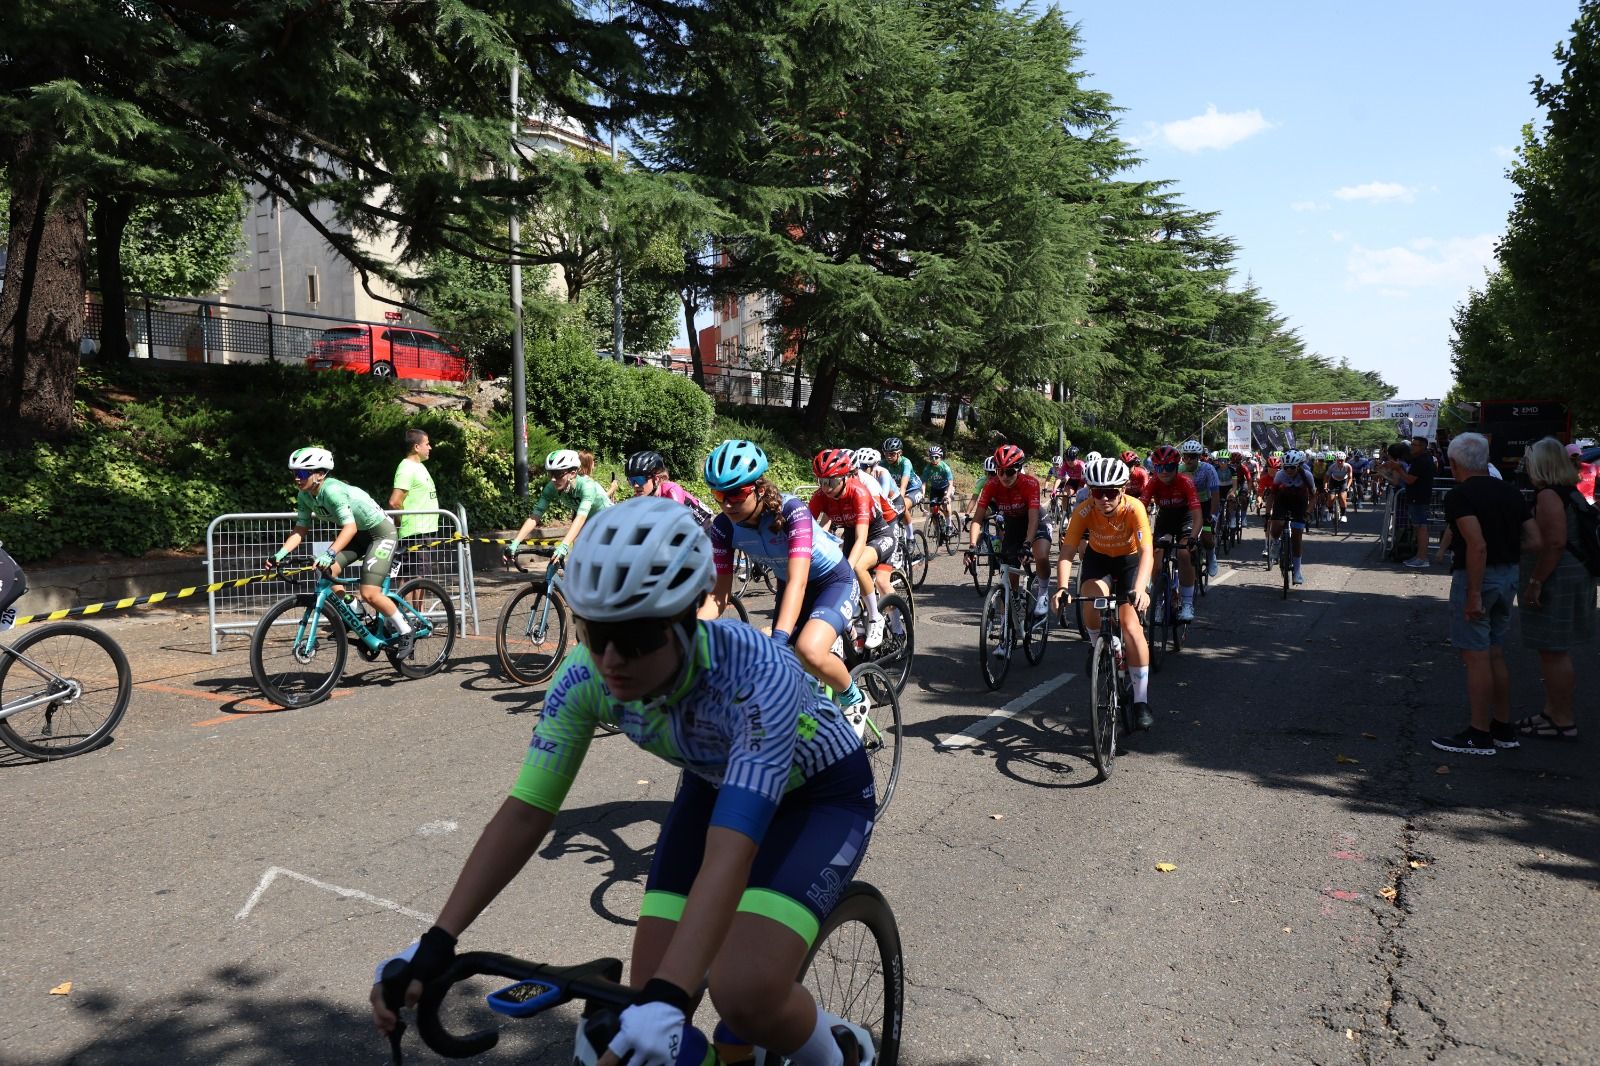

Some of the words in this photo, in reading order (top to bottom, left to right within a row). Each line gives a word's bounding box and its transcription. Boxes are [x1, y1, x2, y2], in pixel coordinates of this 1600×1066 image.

[1, 608, 16, 625] 226
[329, 595, 369, 637] Bianchi
[546, 665, 591, 718] aqualia
[892, 955, 900, 1004] SWISS
